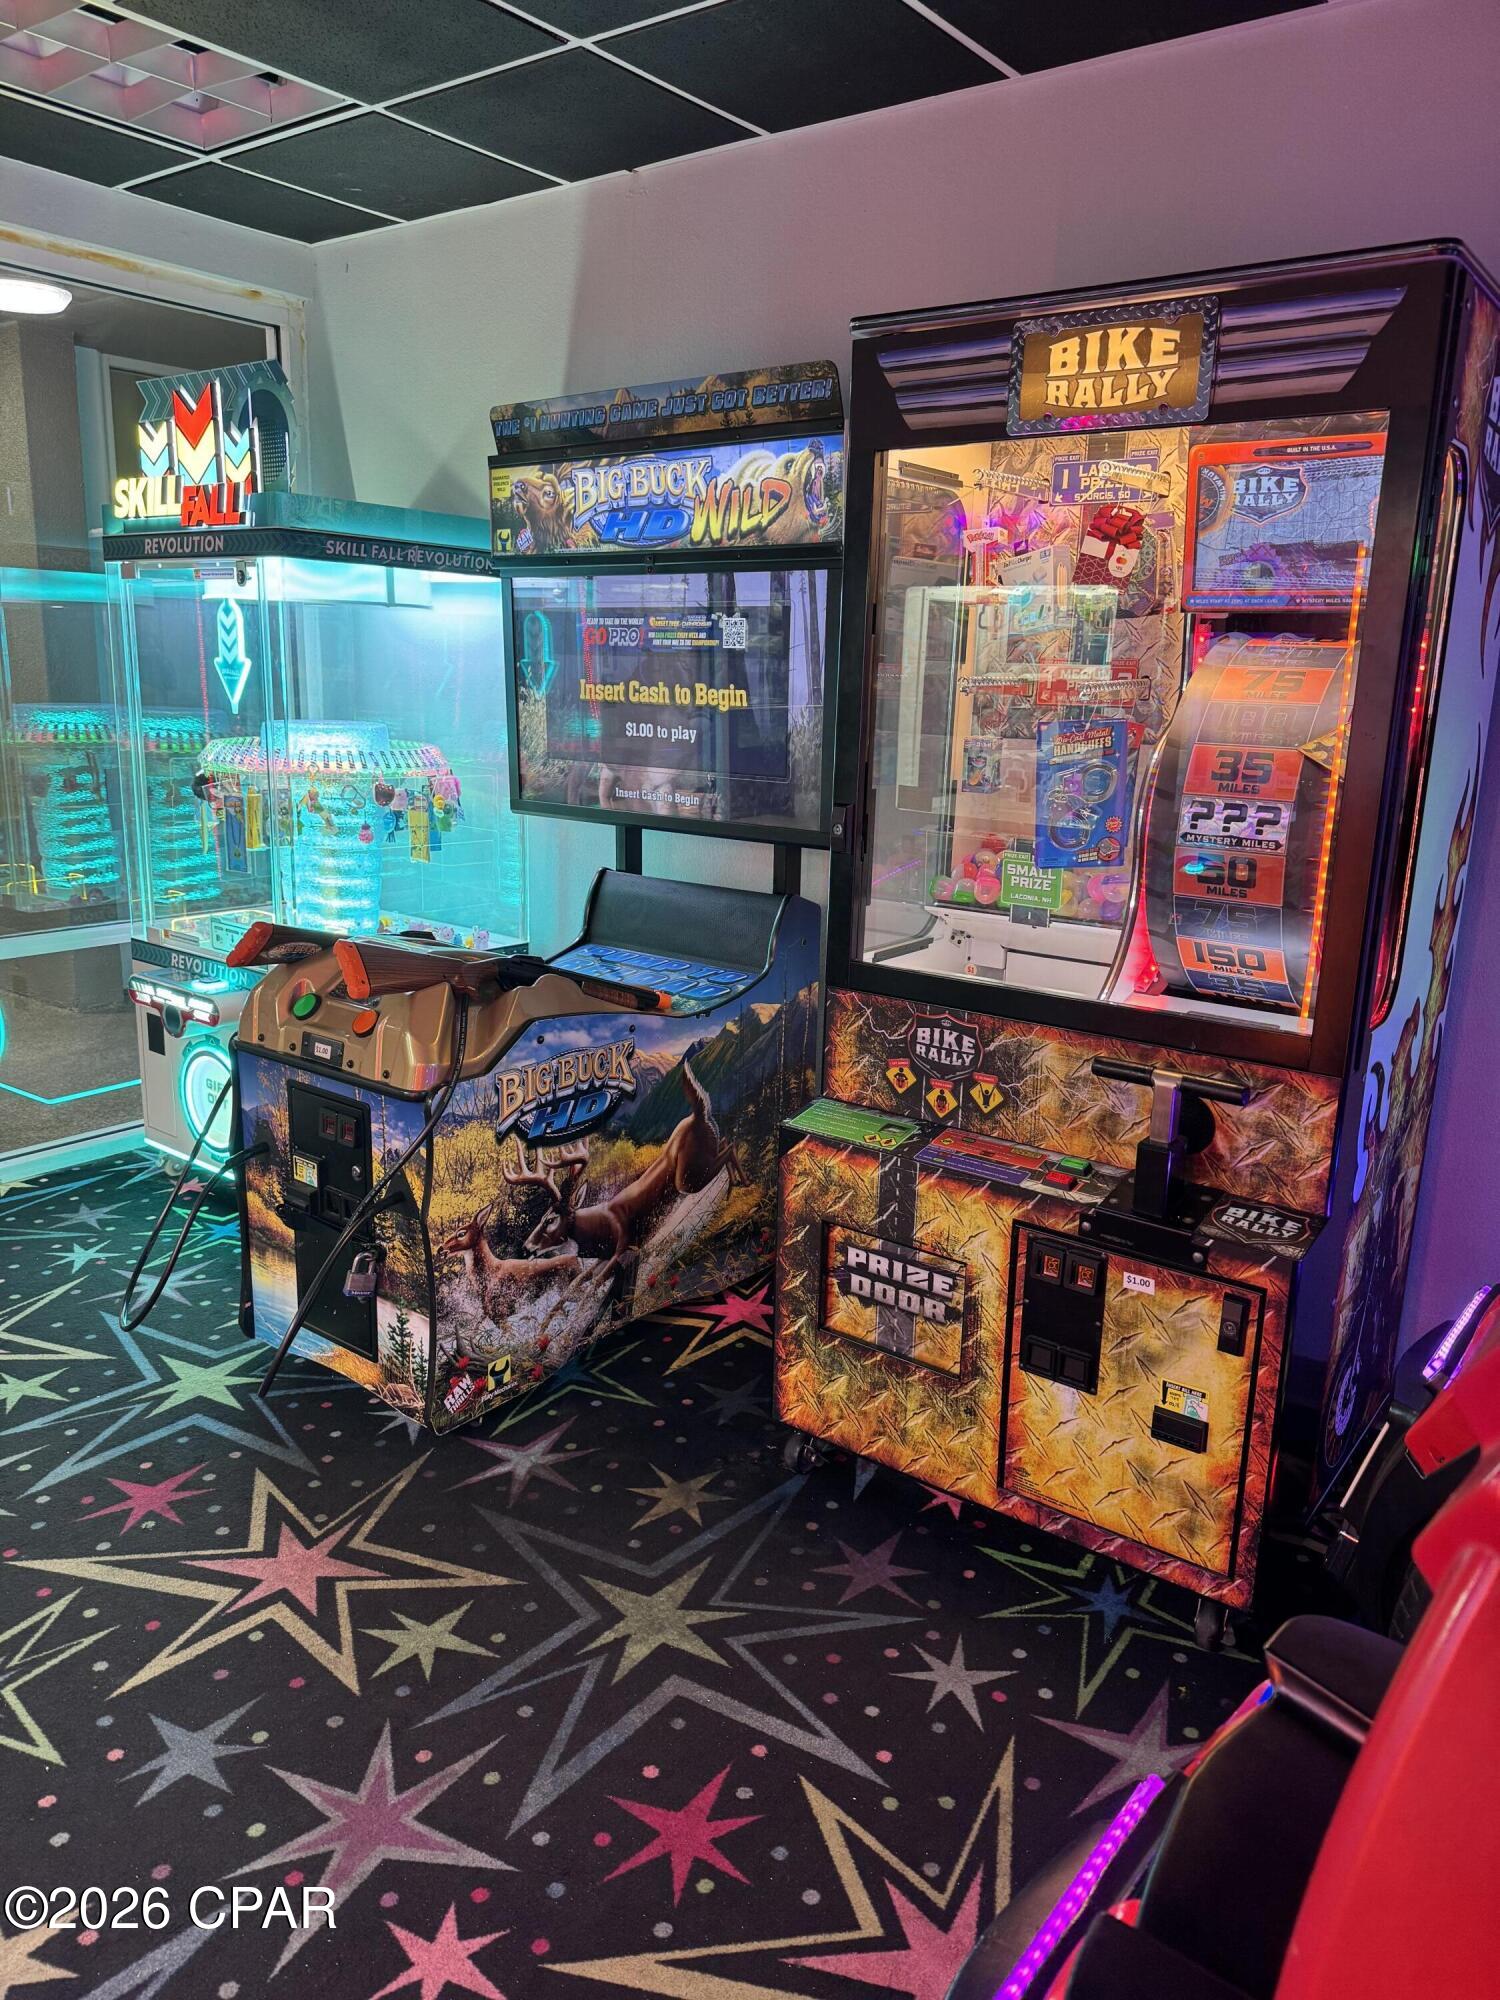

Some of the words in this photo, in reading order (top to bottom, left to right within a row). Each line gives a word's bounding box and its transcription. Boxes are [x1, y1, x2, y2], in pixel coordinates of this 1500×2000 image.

[1047, 326, 1181, 377] BIKE
[1044, 366, 1181, 409] RALLY
[494, 419, 520, 437] THE
[540, 405, 607, 432] HUNTING
[609, 399, 660, 424] GAME
[661, 392, 708, 418] JUST
[711, 387, 748, 412] GOT
[752, 377, 834, 408] BETTER!
[113, 474, 182, 519] SKILL
[573, 466, 628, 517] BIG
[629, 458, 713, 501] BUCK
[1234, 476, 1300, 494] BIKE
[180, 481, 241, 527] FALL
[690, 476, 793, 546] WILD
[602, 508, 690, 542] HD
[144, 535, 224, 555] REVOLUTION
[326, 540, 367, 558] SKILL
[371, 544, 404, 562] FALL
[407, 549, 493, 571] REVOLUTION
[583, 627, 607, 646] GO
[579, 678, 625, 702] Insert
[628, 680, 671, 705] Cash
[675, 683, 691, 705] to
[694, 682, 748, 712] Begin
[1243, 670, 1307, 693] 75
[625, 722, 654, 738] $1.00
[656, 725, 668, 738] to
[671, 725, 697, 743] play
[1211, 750, 1274, 785] 35
[615, 787, 640, 799] Insert
[641, 789, 662, 801] Cash
[664, 792, 673, 802] to
[674, 793, 699, 807] Begin
[1218, 782, 1260, 795] MILES
[1186, 834, 1238, 847] MYSTERY
[1242, 840, 1277, 850] MILES
[1008, 864, 1057, 880] SMALL
[1011, 876, 1052, 892] PRIZE
[1042, 895, 1052, 904] NH
[1206, 885, 1248, 899] MILES
[1194, 901, 1257, 930] 75
[171, 953, 248, 986] REVOLUTION
[1193, 941, 1267, 972] 150
[1213, 964, 1254, 976] MILES
[915, 1043, 975, 1067] RALLY
[916, 1027, 976, 1055] BIKE
[206, 1078, 225, 1093] GIF
[498, 1063, 552, 1122] BIG
[557, 1040, 634, 1092] BUCK
[527, 1089, 611, 1139] HD
[1221, 1214, 1298, 1238] RALLY
[1227, 1206, 1303, 1233] BIKE
[847, 1245, 954, 1299] PRIZE
[1126, 1275, 1151, 1290] $1.00
[850, 1272, 948, 1325] DOOR
[444, 1373, 474, 1411] RAW
